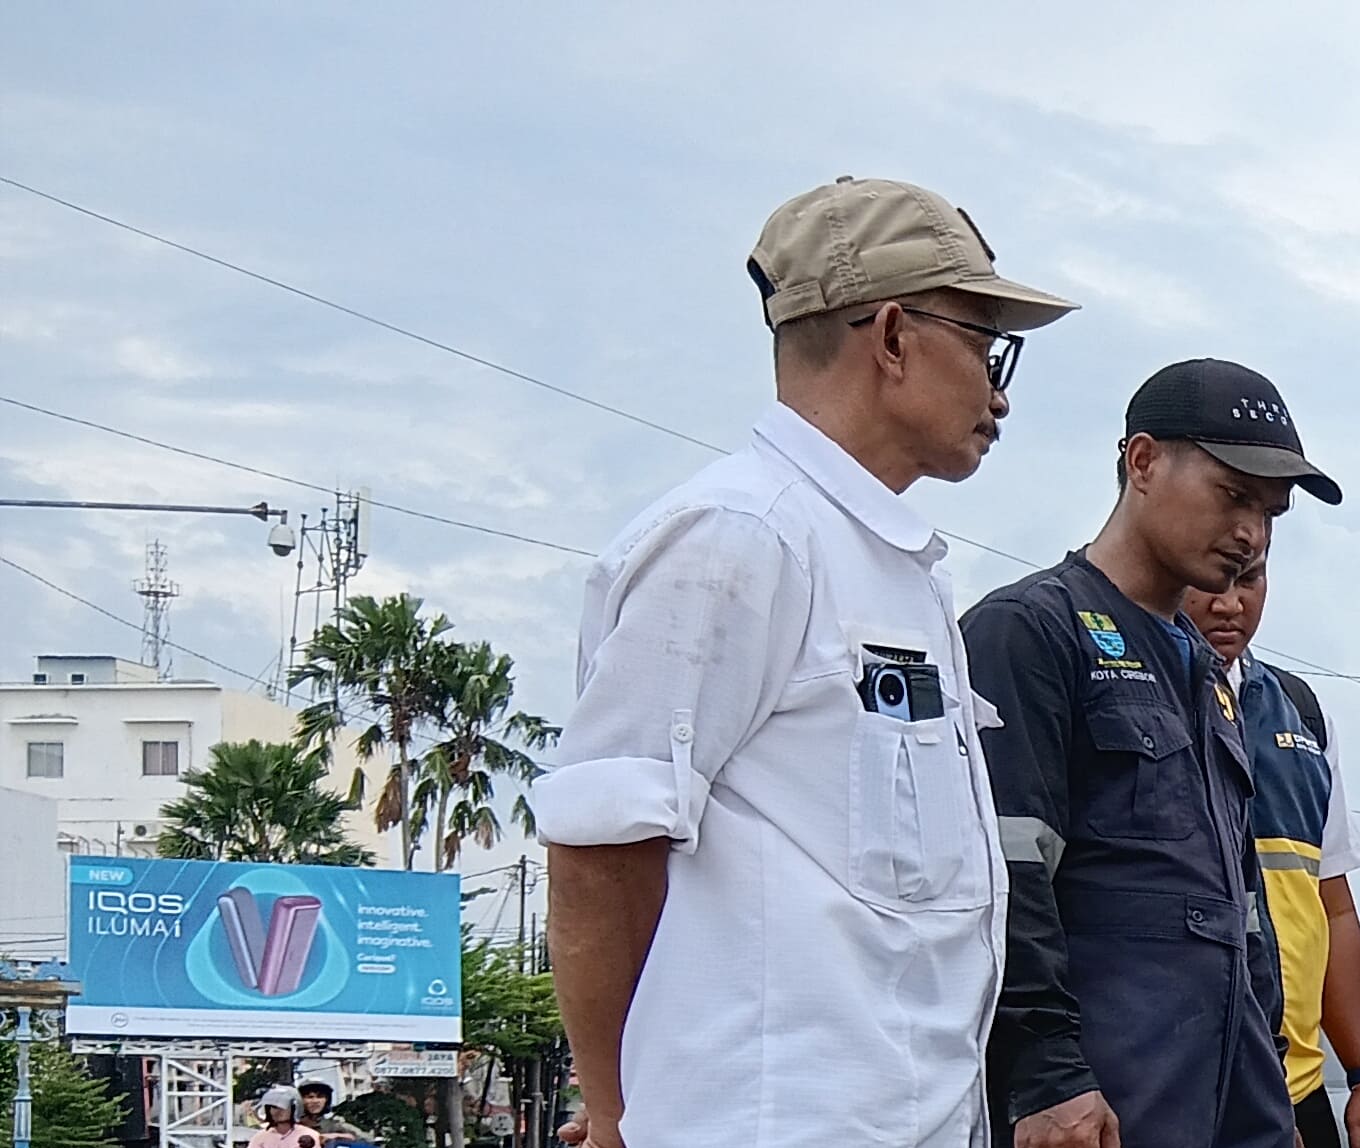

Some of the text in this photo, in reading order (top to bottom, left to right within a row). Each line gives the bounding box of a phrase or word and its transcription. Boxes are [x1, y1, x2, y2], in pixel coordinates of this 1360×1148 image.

[1090, 668, 1120, 681] KOTA
[88, 869, 125, 882] NEW
[88, 890, 184, 915] IQOS
